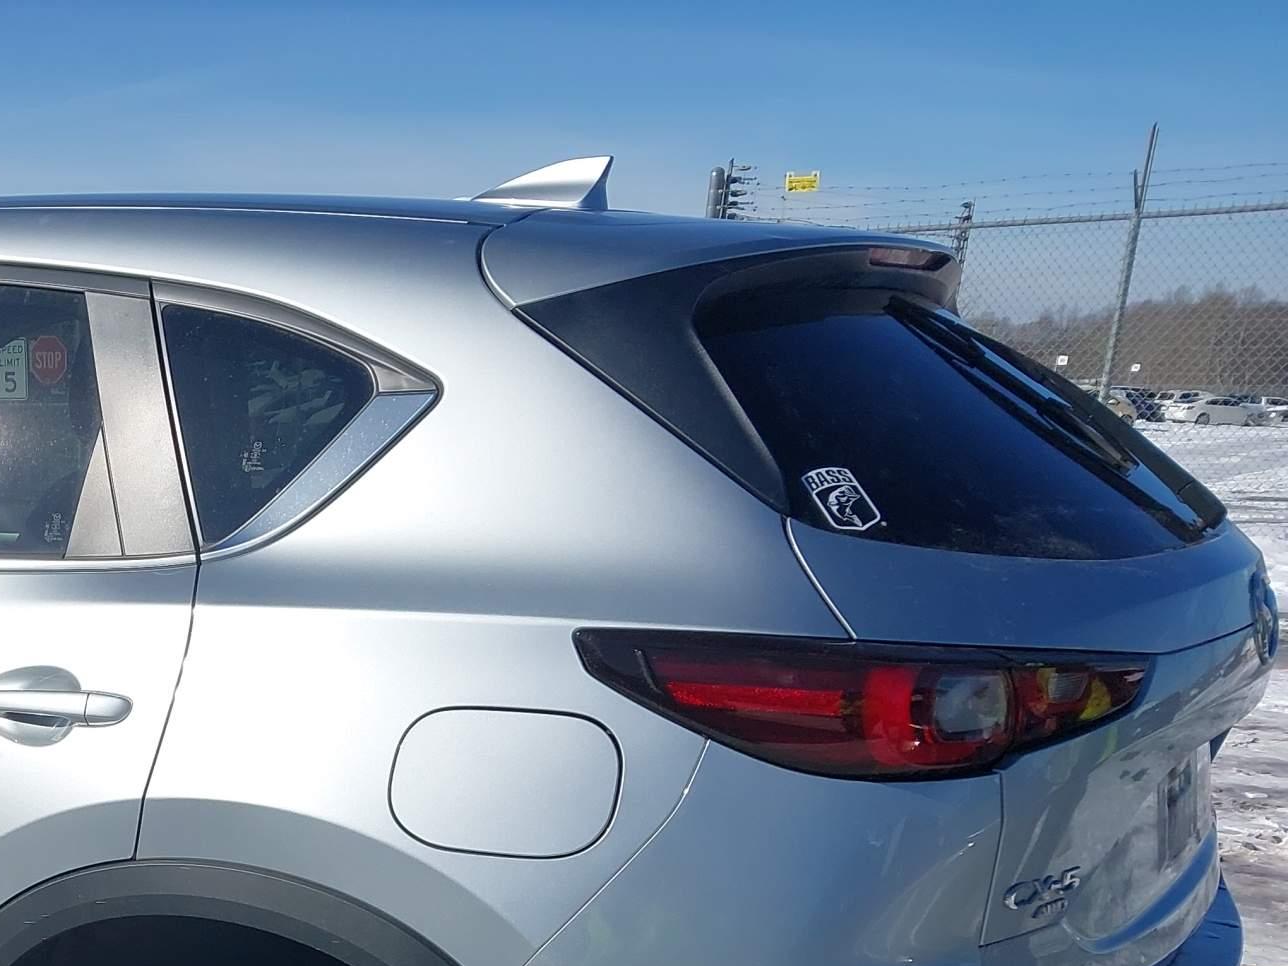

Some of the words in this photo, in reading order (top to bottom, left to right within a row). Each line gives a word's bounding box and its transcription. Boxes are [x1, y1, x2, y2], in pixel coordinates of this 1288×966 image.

[0, 358, 20, 367] LIMIT
[35, 351, 62, 369] STOP
[4, 371, 17, 393] 5
[807, 468, 854, 491] BASS
[1003, 865, 1081, 910] CX-5
